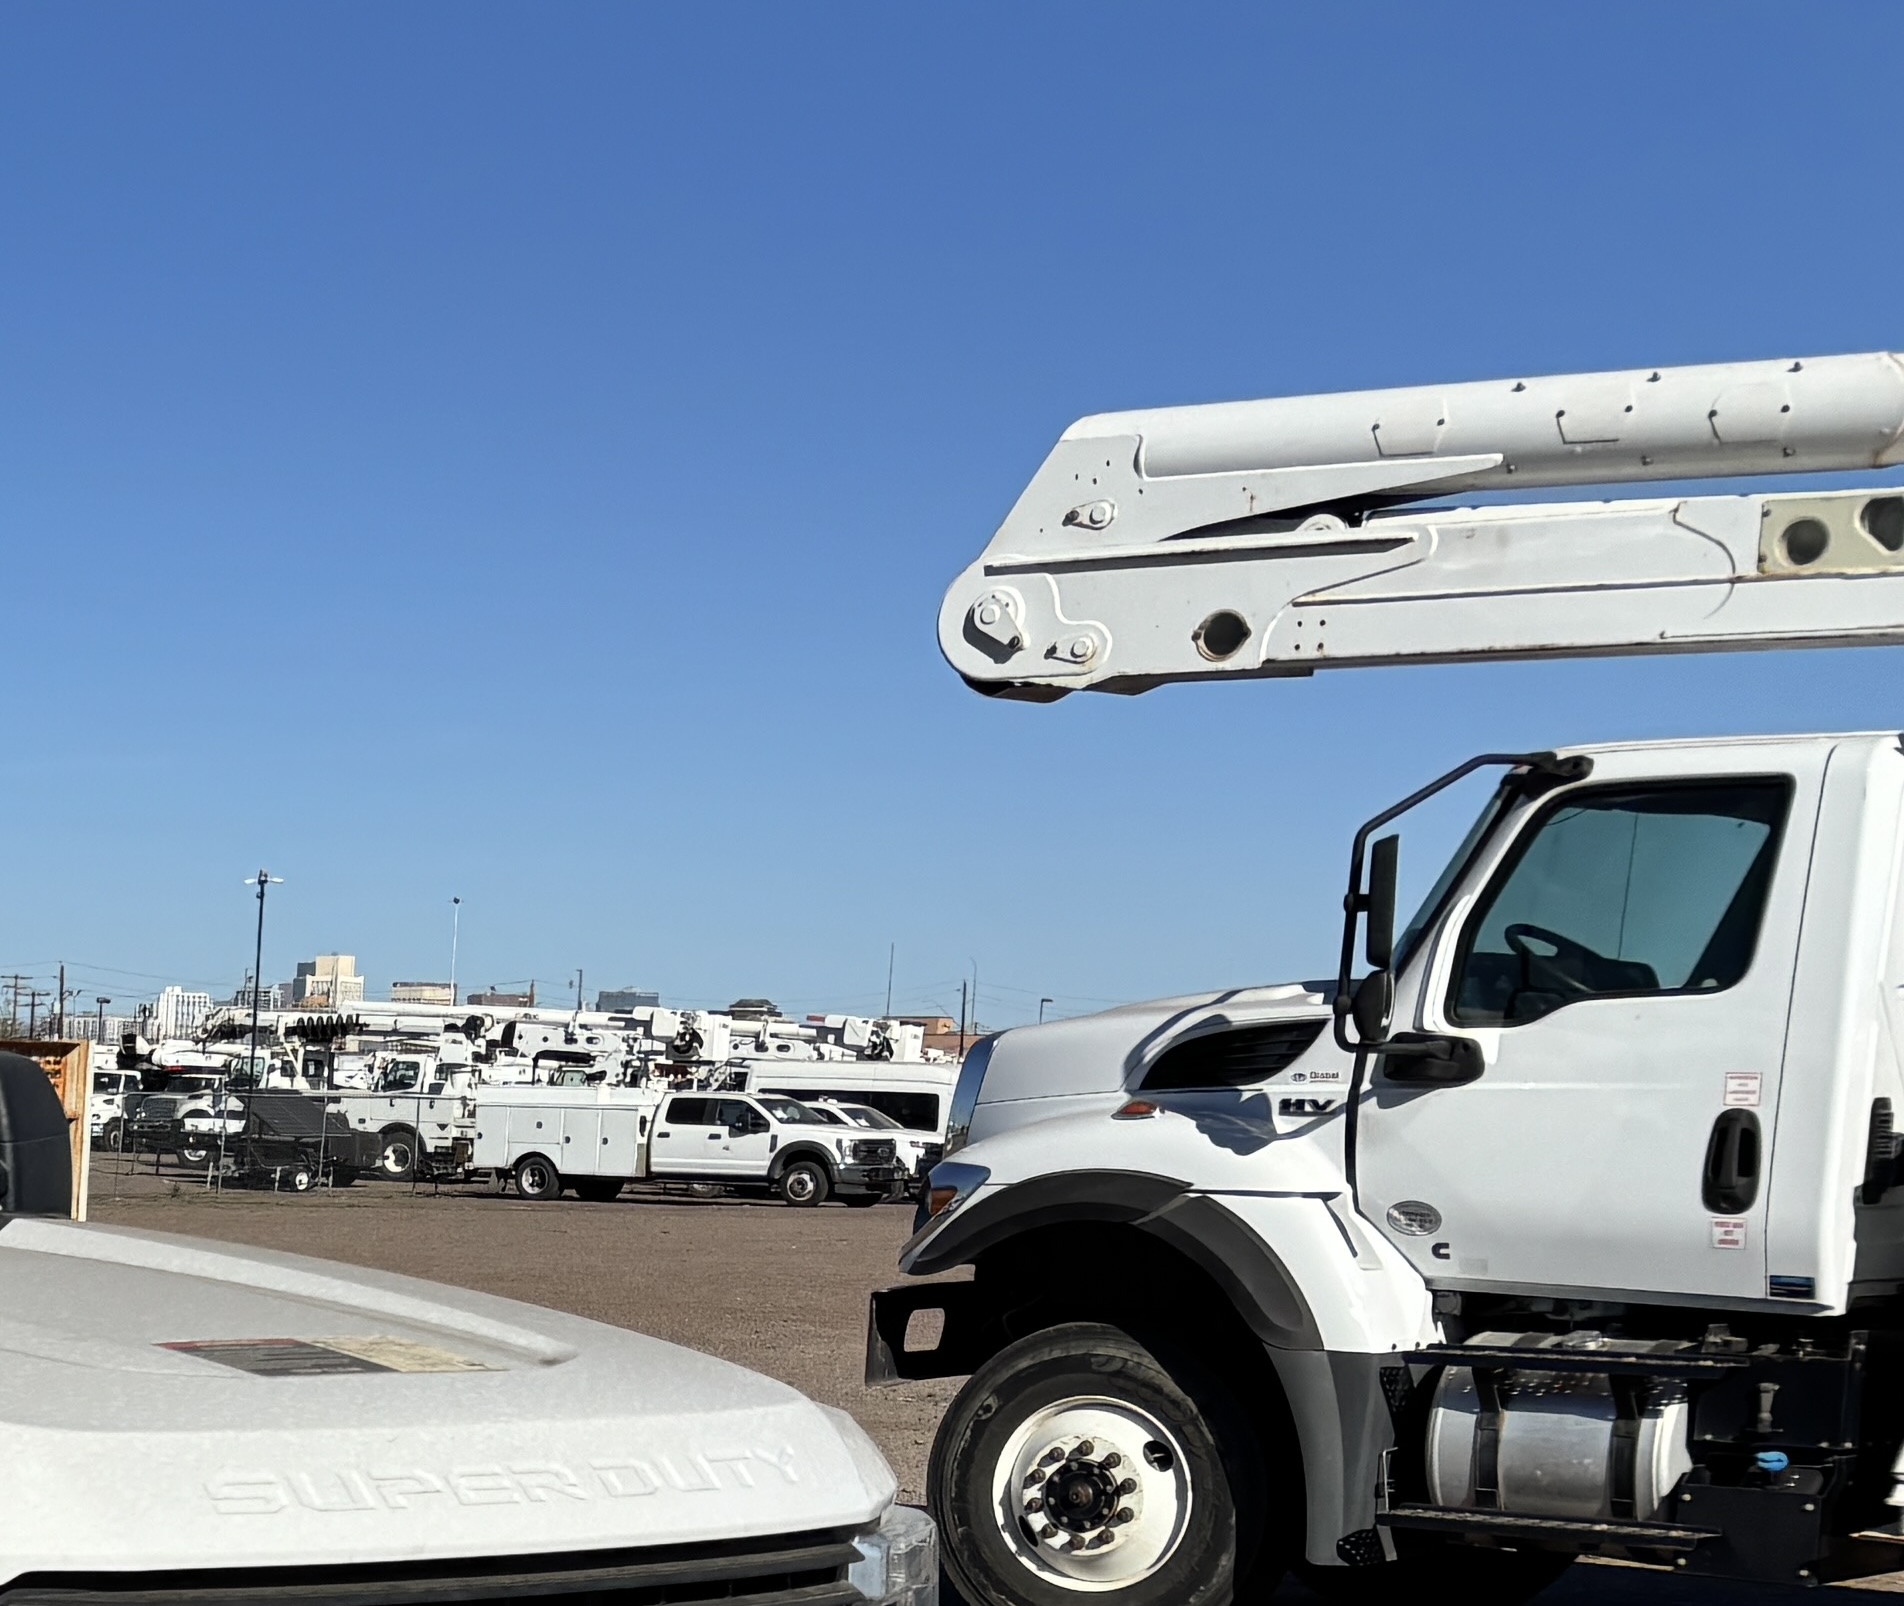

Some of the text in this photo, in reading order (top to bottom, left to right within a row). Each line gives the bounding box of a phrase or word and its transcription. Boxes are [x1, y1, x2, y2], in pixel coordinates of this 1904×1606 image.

[1279, 1098, 1337, 1115] HV
[202, 1445, 800, 1516] SUPER DUTY
